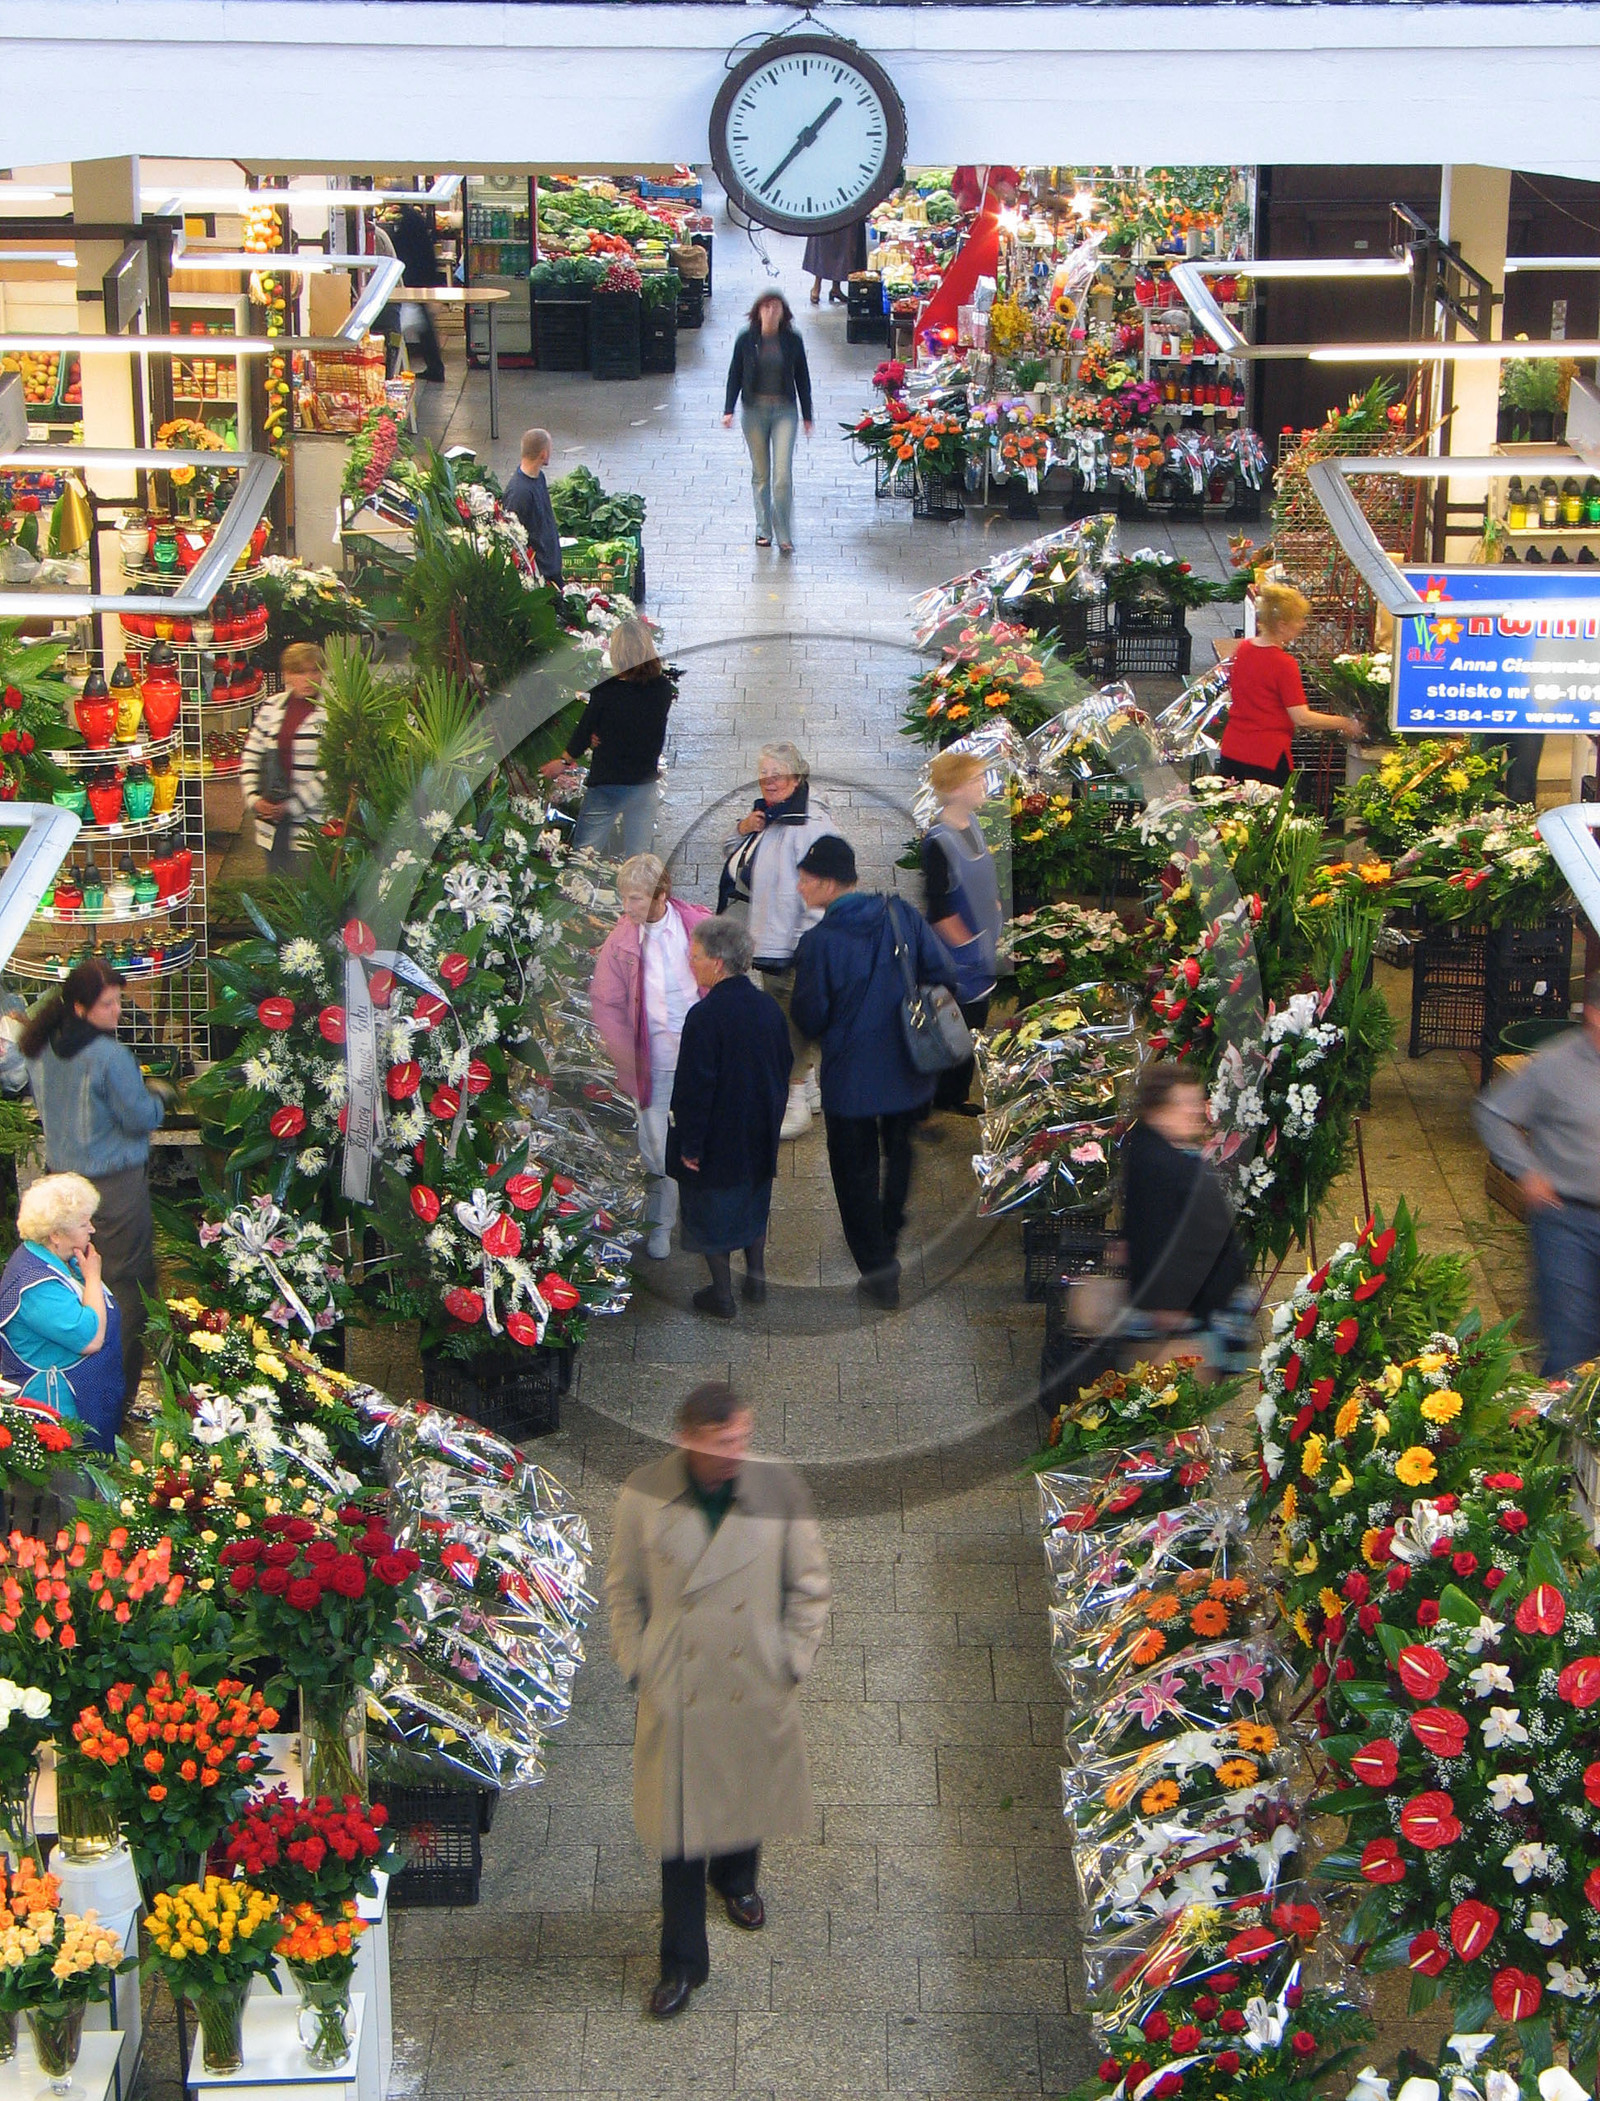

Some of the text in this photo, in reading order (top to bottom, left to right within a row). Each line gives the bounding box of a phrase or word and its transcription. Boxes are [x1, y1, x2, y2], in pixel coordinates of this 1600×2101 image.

[1449, 657, 1498, 671] Anna
[1427, 683, 1502, 699] stoisko
[1507, 687, 1530, 699] nr
[1409, 708, 1518, 722] 34-384-57
